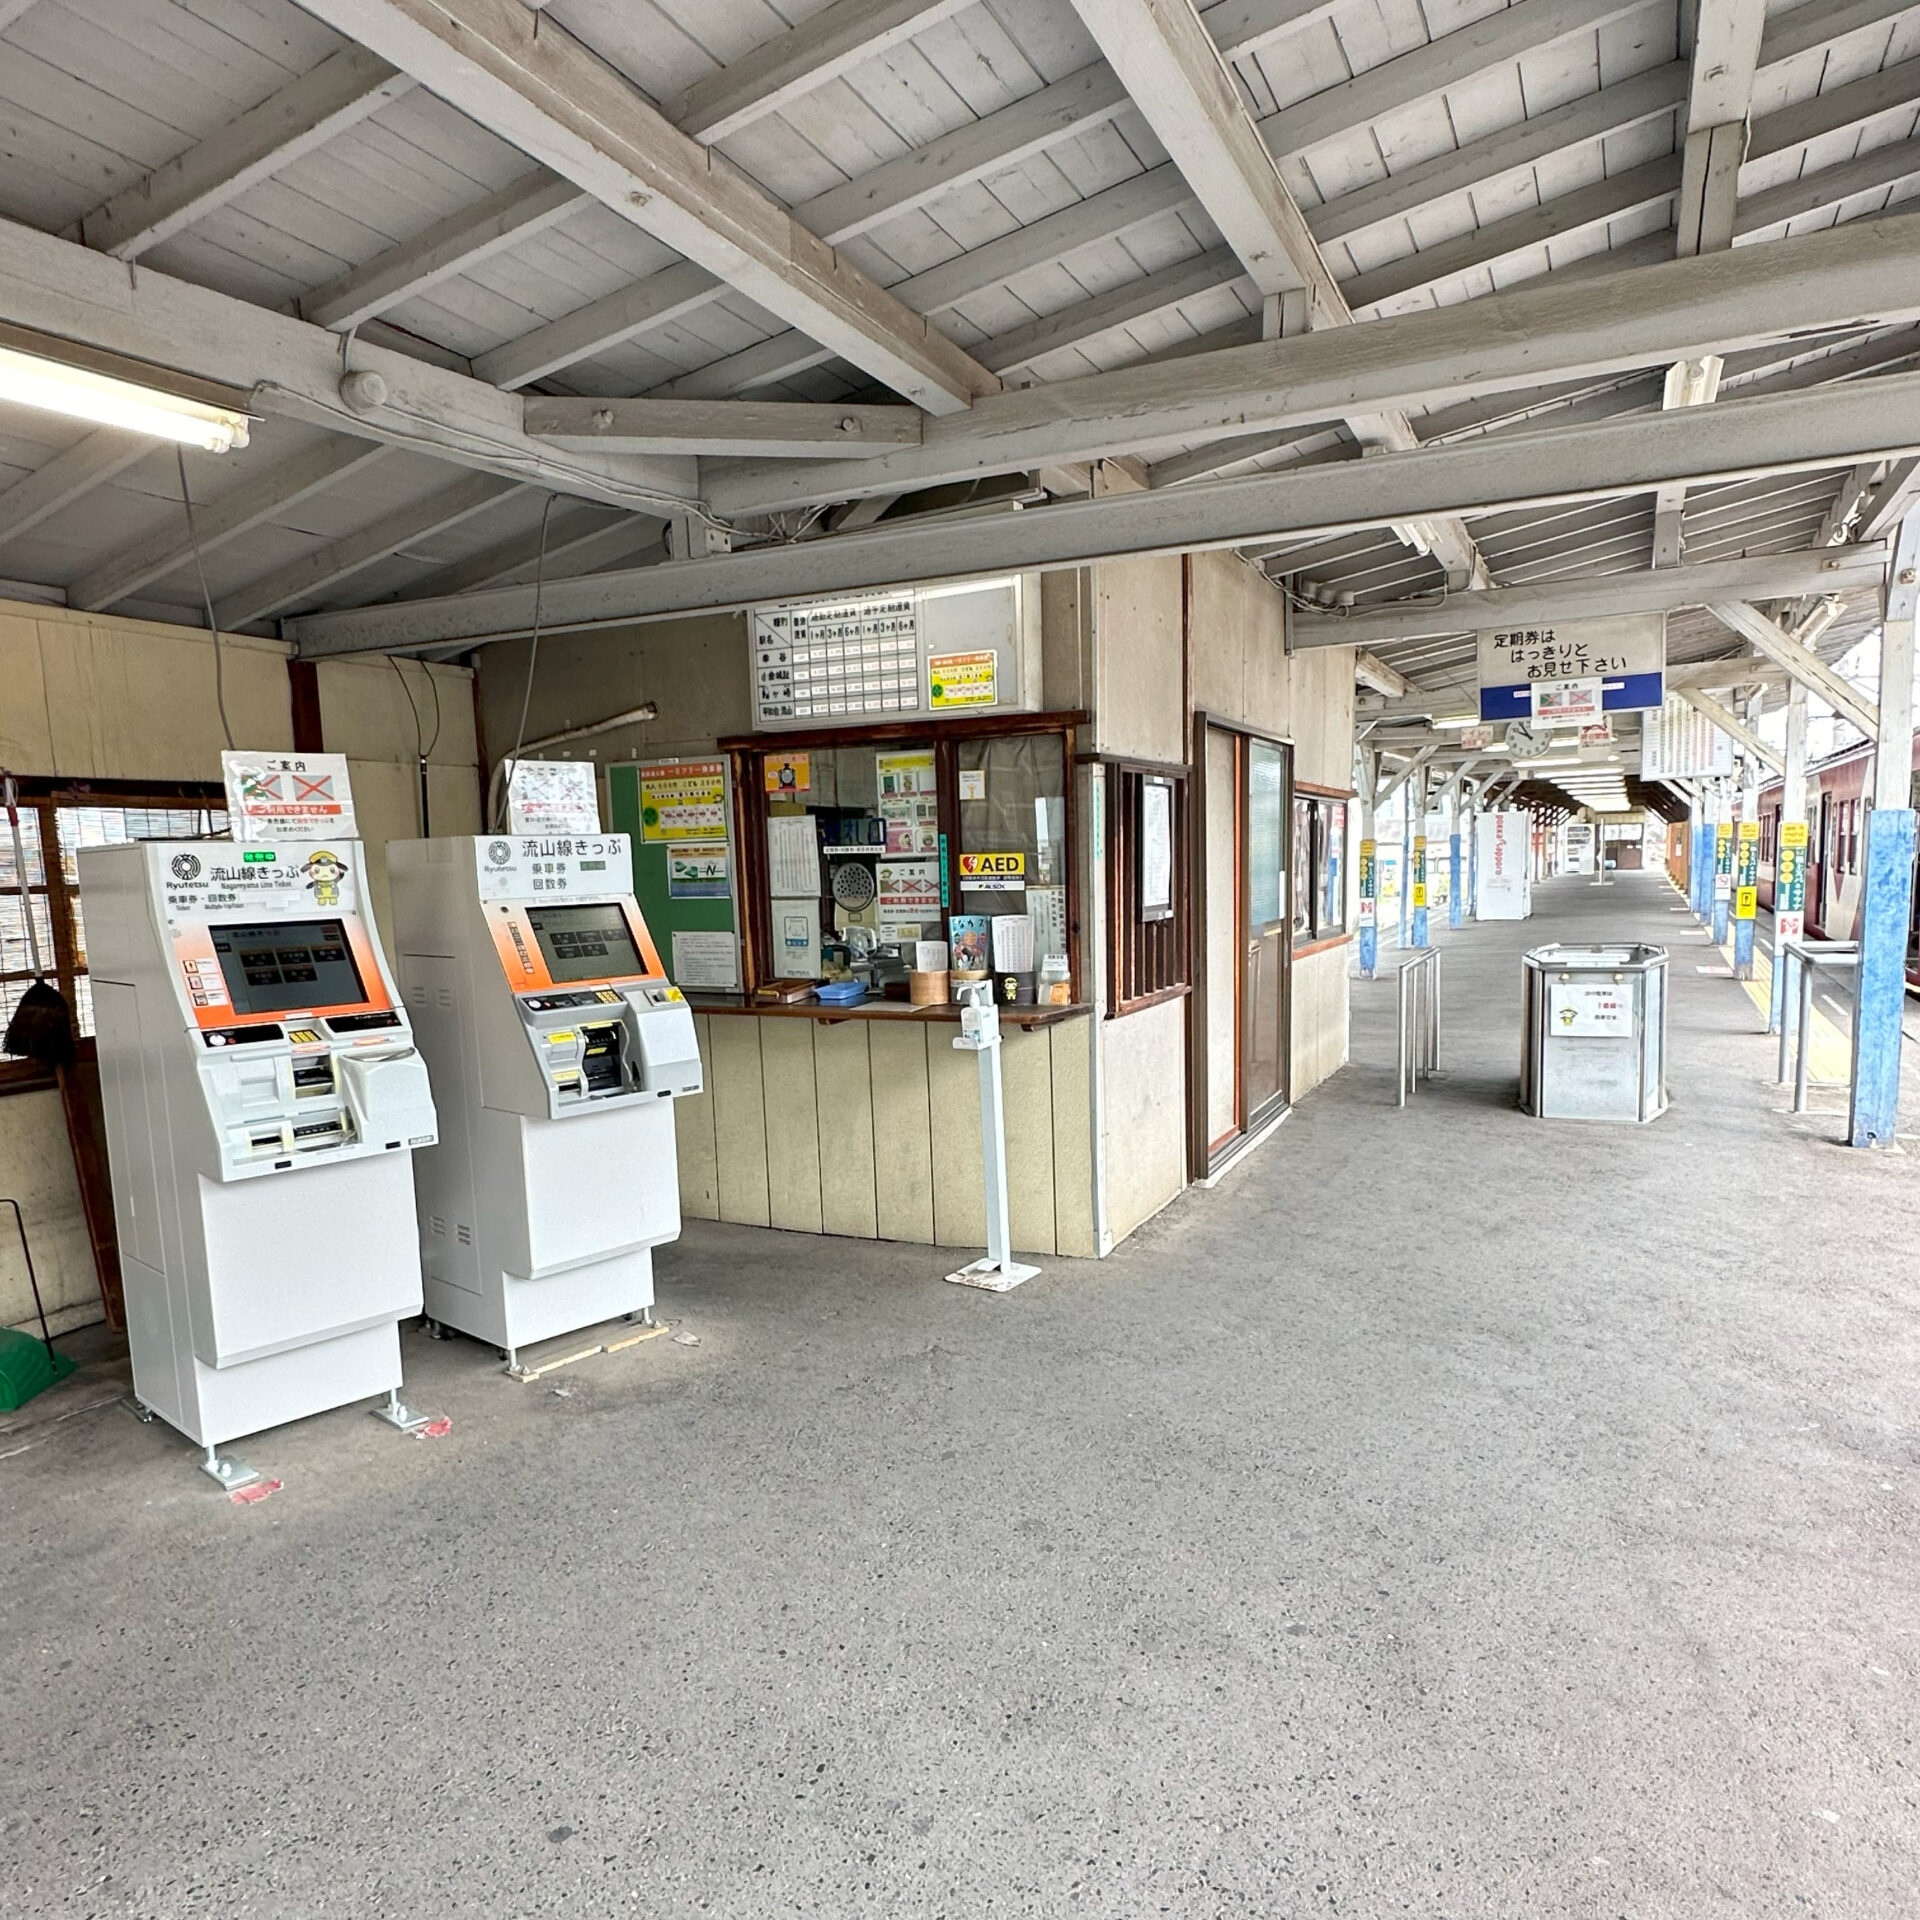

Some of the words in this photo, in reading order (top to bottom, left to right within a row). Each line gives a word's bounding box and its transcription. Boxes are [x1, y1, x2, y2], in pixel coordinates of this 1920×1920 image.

[1494, 629, 1556, 649] 定期券は
[1511, 643, 1589, 664] はっきりと
[1527, 656, 1627, 679] お見せ下さい
[267, 761, 306, 772] ご案内
[522, 840, 622, 858] 流山線きっぷ
[485, 865, 517, 874] Ryutetsu
[532, 863, 566, 875] 乗車券
[980, 857, 1019, 872] AED
[210, 867, 299, 881] 流山線きっぷ
[166, 880, 209, 889] Ryutetsu
[533, 878, 567, 891] 回数券
